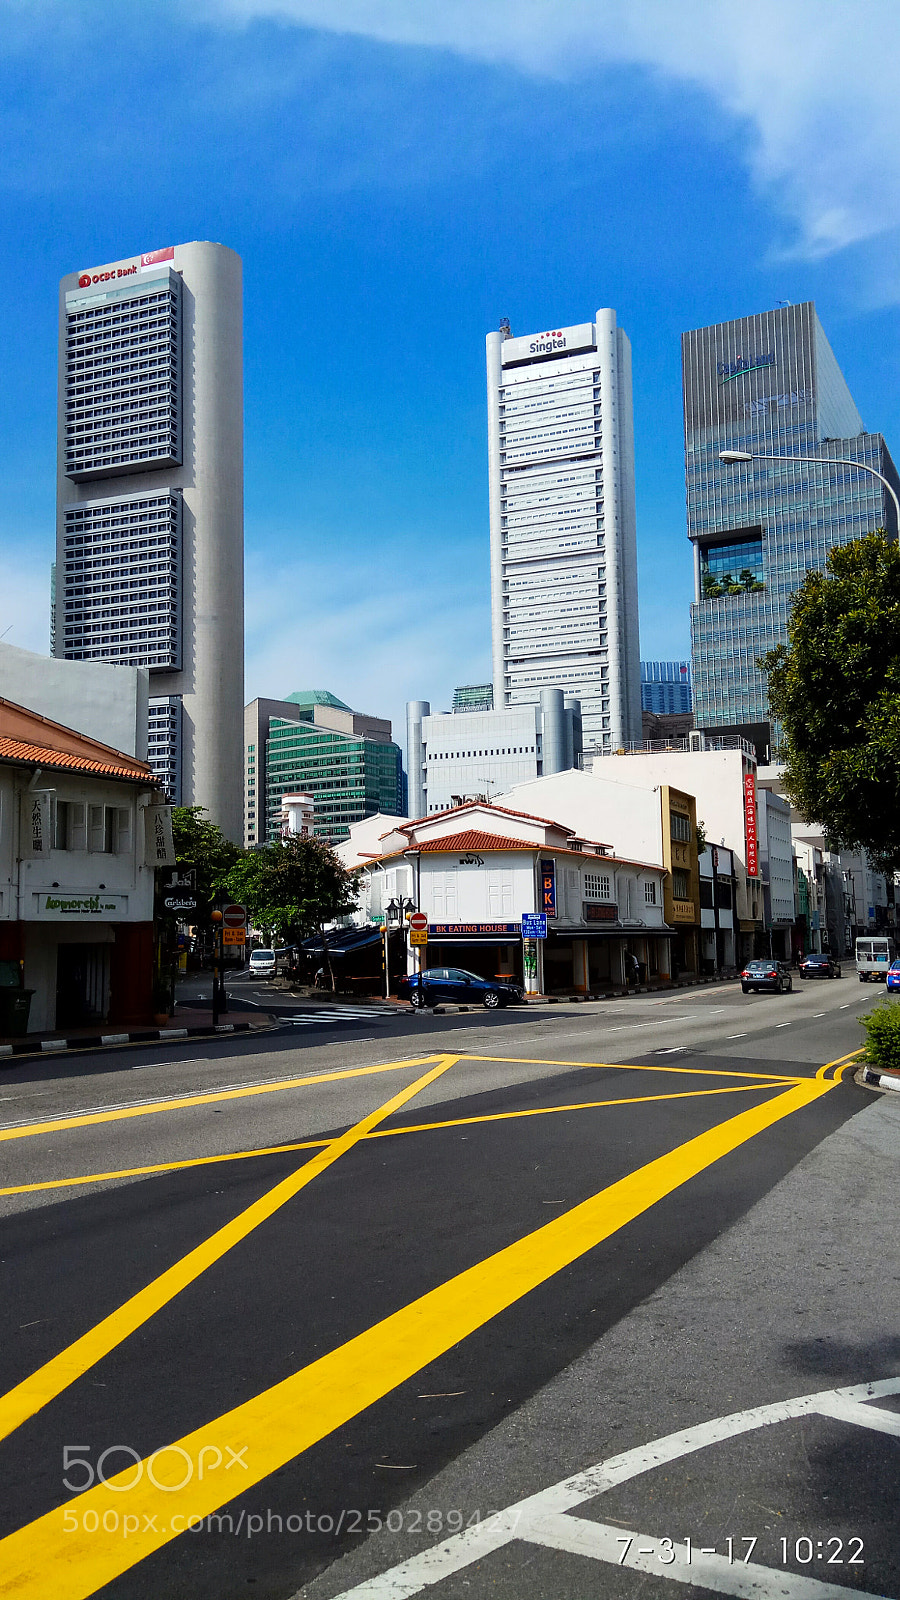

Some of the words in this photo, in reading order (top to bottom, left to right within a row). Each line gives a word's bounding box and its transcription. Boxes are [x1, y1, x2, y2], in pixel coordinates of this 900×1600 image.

[92, 270, 116, 284] OCBC
[117, 264, 138, 278] Bank
[529, 337, 567, 353] Singtel
[716, 351, 775, 376] CapitaLand
[164, 897, 197, 909] Carlsberg
[435, 925, 446, 933] BK
[448, 925, 477, 933] EATING
[479, 924, 508, 932] HOUSE
